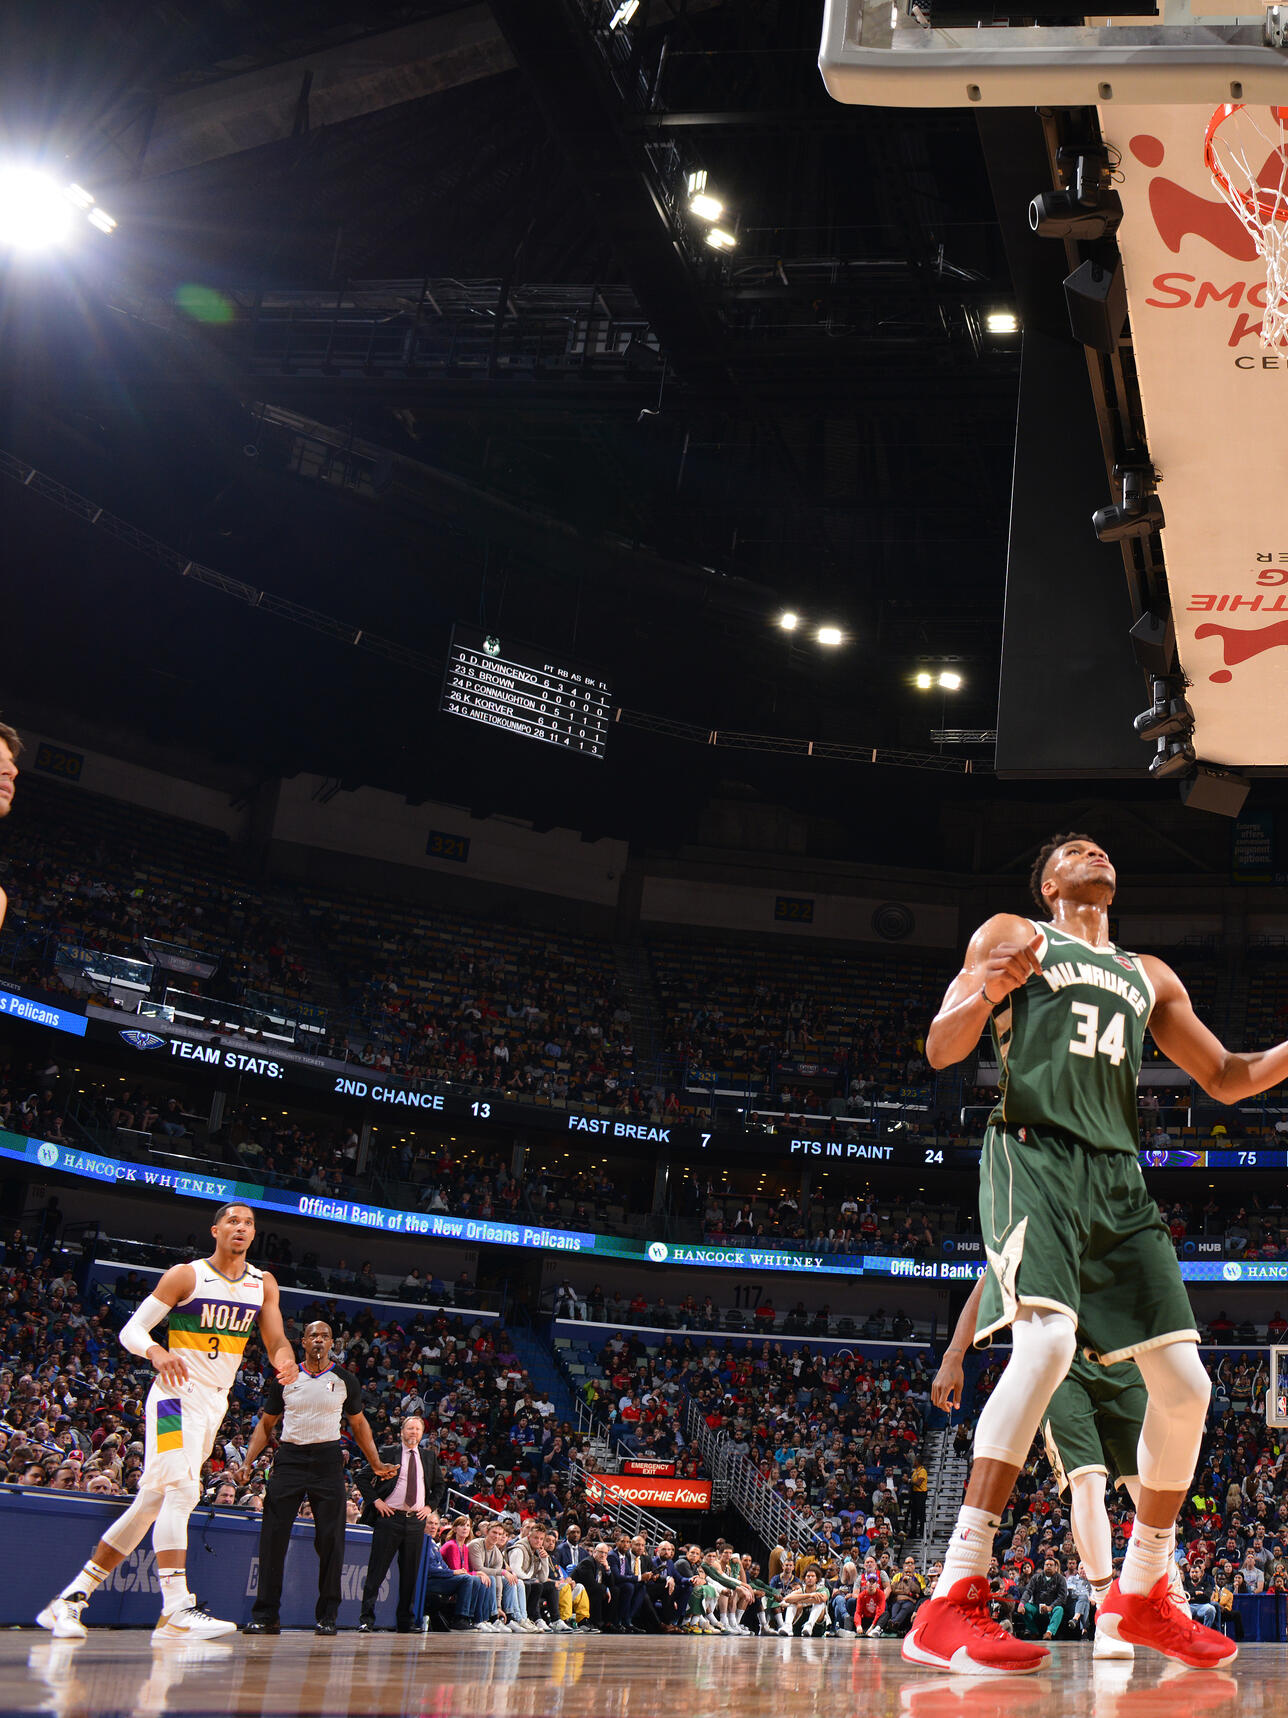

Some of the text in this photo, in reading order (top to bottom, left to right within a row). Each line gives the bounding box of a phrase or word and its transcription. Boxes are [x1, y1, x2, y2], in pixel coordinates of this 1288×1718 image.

[460, 653, 465, 661] 0
[482, 660, 538, 684] DIVINCENZO
[544, 679, 549, 687] 6
[558, 684, 563, 692] 3
[571, 688, 577, 696] 4
[600, 697, 604, 705] 1
[544, 664, 554, 673] PT
[558, 669, 568, 677] RB
[571, 674, 581, 682] AS
[585, 678, 595, 686] BK
[452, 678, 464, 687] 24
[474, 684, 536, 709] CONNAUGHTON
[540, 704, 546, 712] 0
[583, 717, 587, 725] 1
[597, 721, 601, 729] 1
[455, 665, 466, 674] 23
[479, 672, 515, 688] BROWN
[555, 696, 561, 704] 0
[570, 700, 575, 708] 0
[583, 704, 589, 712] 0
[596, 708, 603, 716] 0
[450, 691, 462, 700] 26
[475, 698, 514, 716] KORVER
[538, 717, 544, 725] 6
[552, 721, 558, 729] 0
[579, 730, 585, 738] 0
[448, 704, 460, 713] 34
[470, 710, 532, 733] ANTETOKOUNMPO
[533, 729, 544, 738] 28
[550, 733, 559, 741] 11
[579, 742, 584, 750] 1
[592, 746, 597, 754] 3
[39, 748, 80, 776] 320
[430, 837, 466, 858] 321
[776, 898, 812, 918] 322
[1041, 961, 1147, 1018] MILWAUKEE
[9, 996, 60, 1027] Pelicans
[1068, 1000, 1126, 1067] 34
[170, 1039, 284, 1080] TEAM STATS:
[334, 1077, 491, 1119] 2ND CHANCE 13
[567, 1114, 711, 1149] FAST BREAK 7
[790, 1139, 944, 1165] PTS IN PAINT 24
[1238, 1151, 1258, 1166] 75
[62, 1153, 227, 1197] HANCOCK WHITNEY
[298, 1195, 582, 1252] Official Bank of the New Orleans Pelicans
[673, 1248, 824, 1269] HANCOCK WHITNEY
[956, 1240, 980, 1252] HUB
[1198, 1242, 1222, 1253] HUB
[889, 1259, 973, 1279] Official Bank
[733, 1284, 763, 1309] 117
[200, 1302, 257, 1331] NOLA
[207, 1336, 220, 1360] 3
[631, 1462, 669, 1470] EMERGENCY
[609, 1485, 674, 1502] SMOOTHIE
